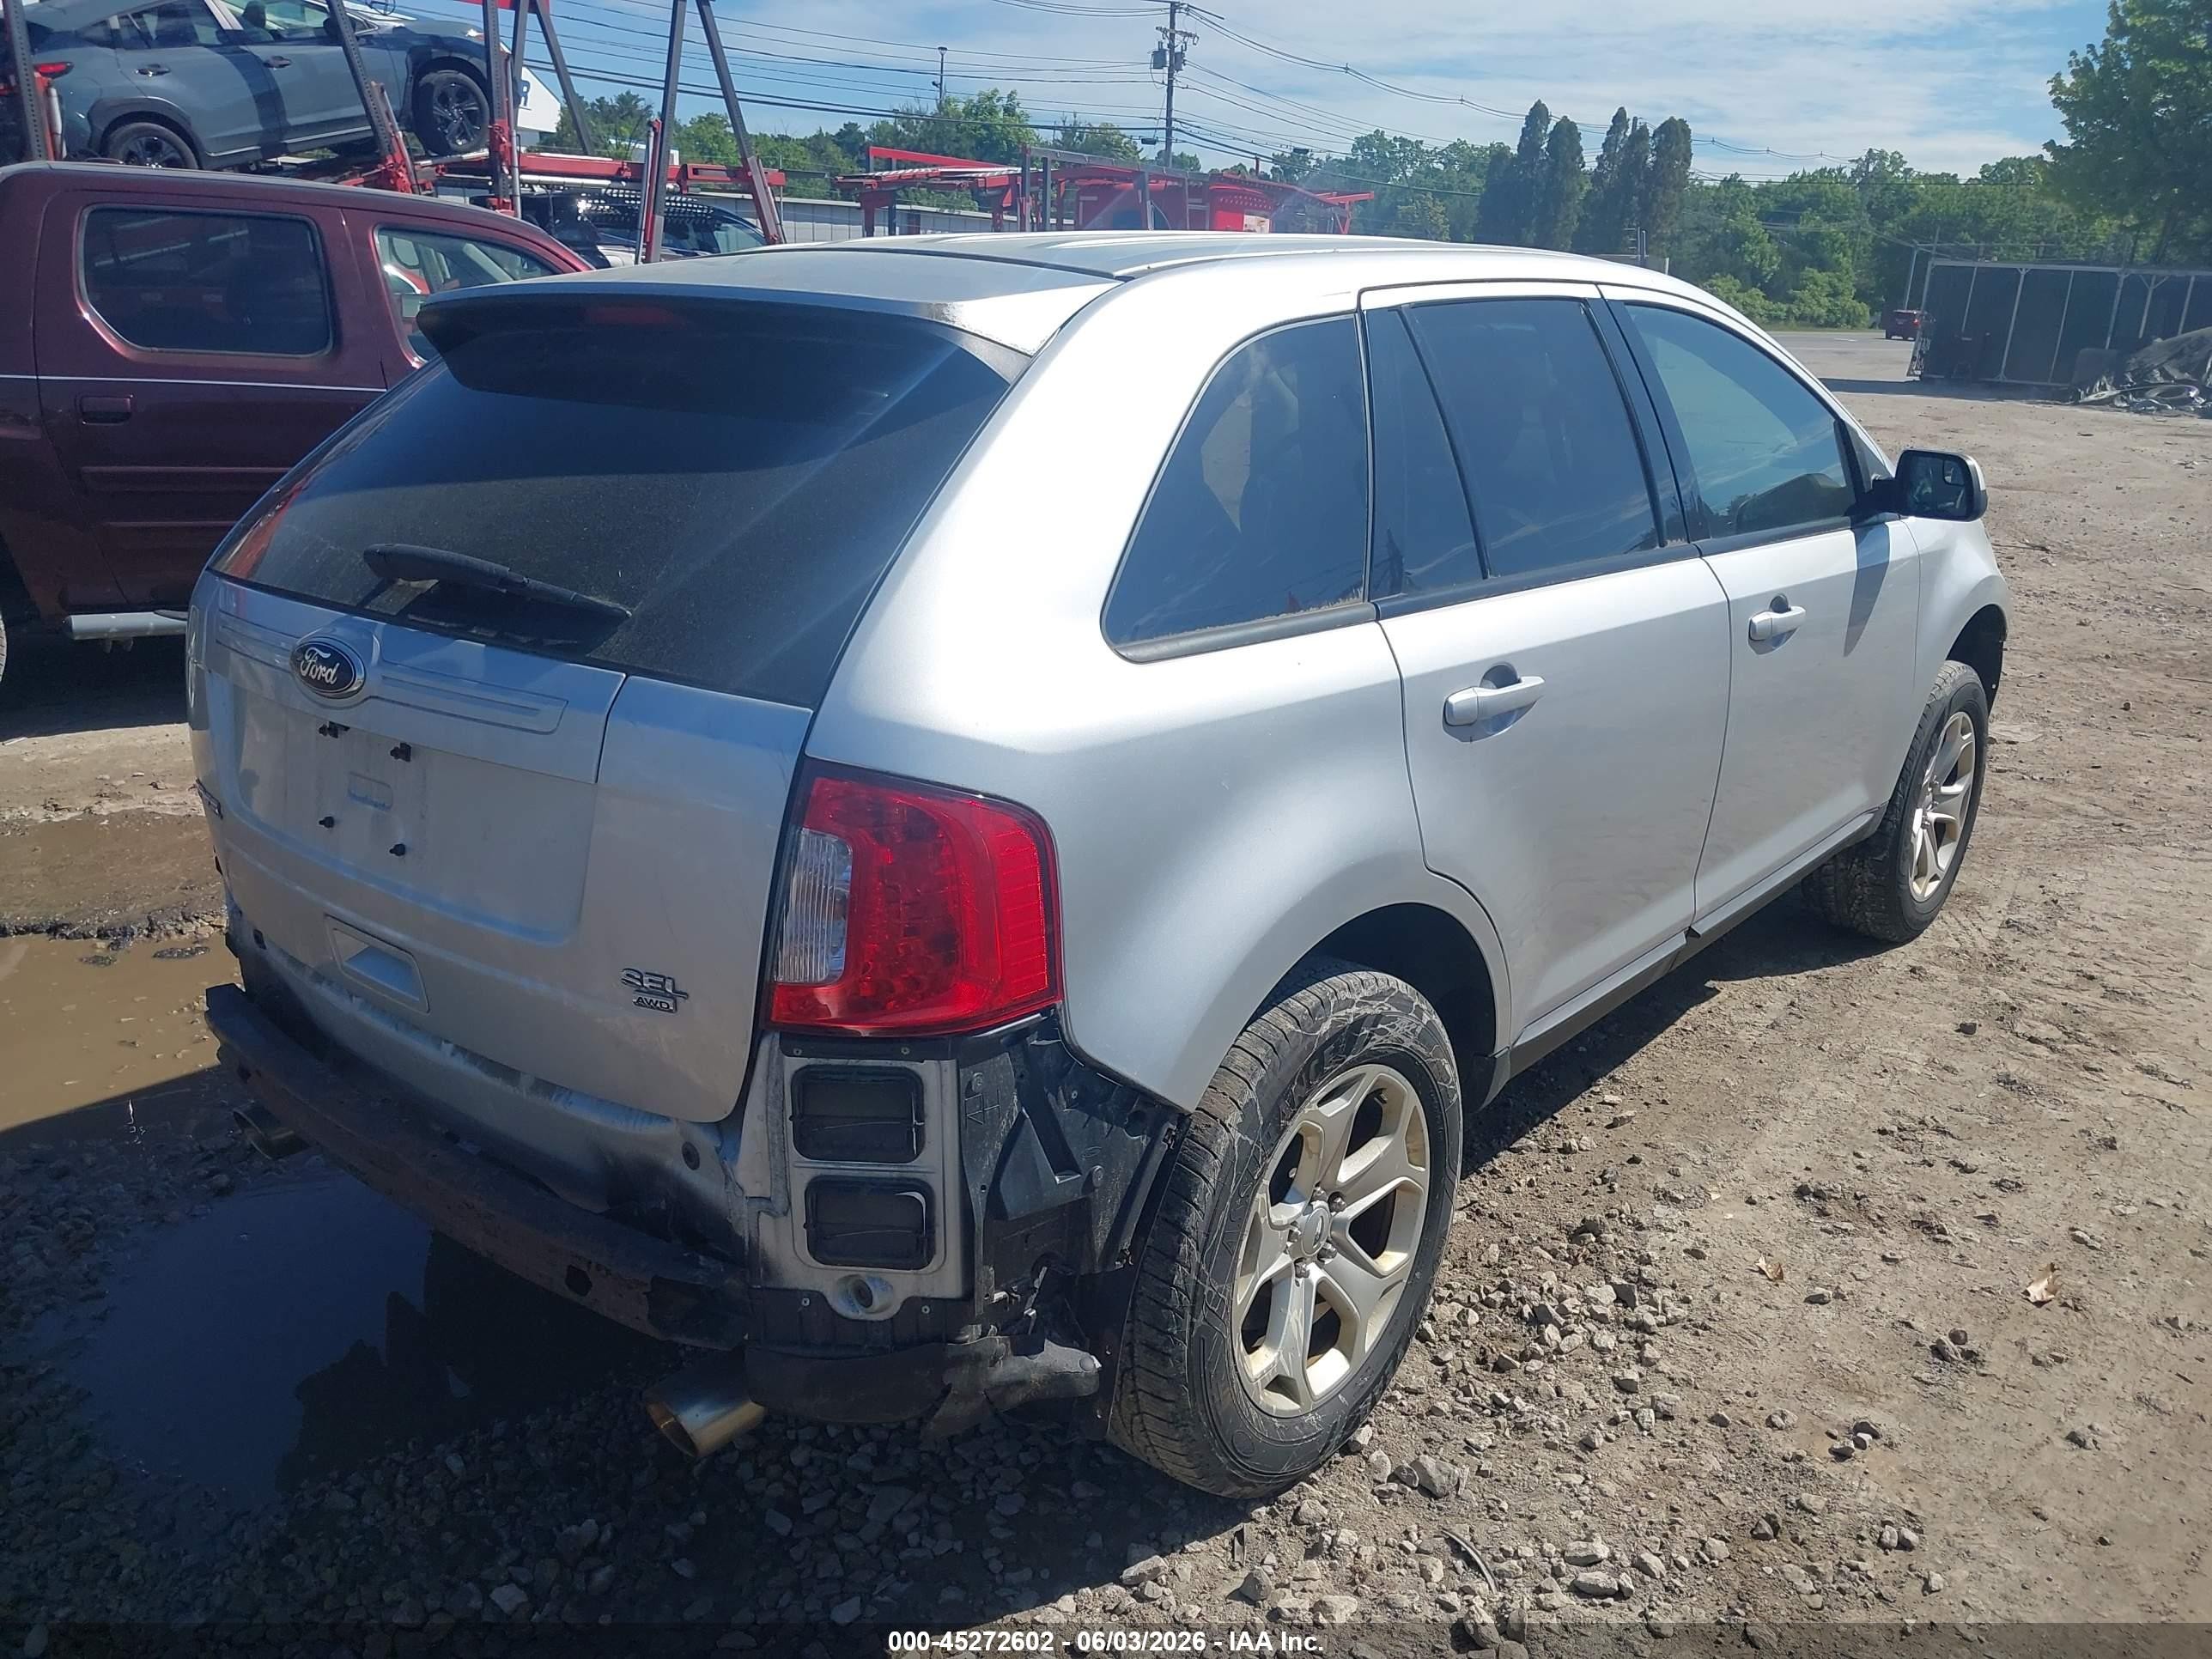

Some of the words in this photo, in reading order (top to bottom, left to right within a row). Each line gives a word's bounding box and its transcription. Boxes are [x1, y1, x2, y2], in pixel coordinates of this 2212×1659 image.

[300, 647, 341, 685] Ford
[620, 967, 689, 1000] SEL
[635, 996, 671, 1011] AWD
